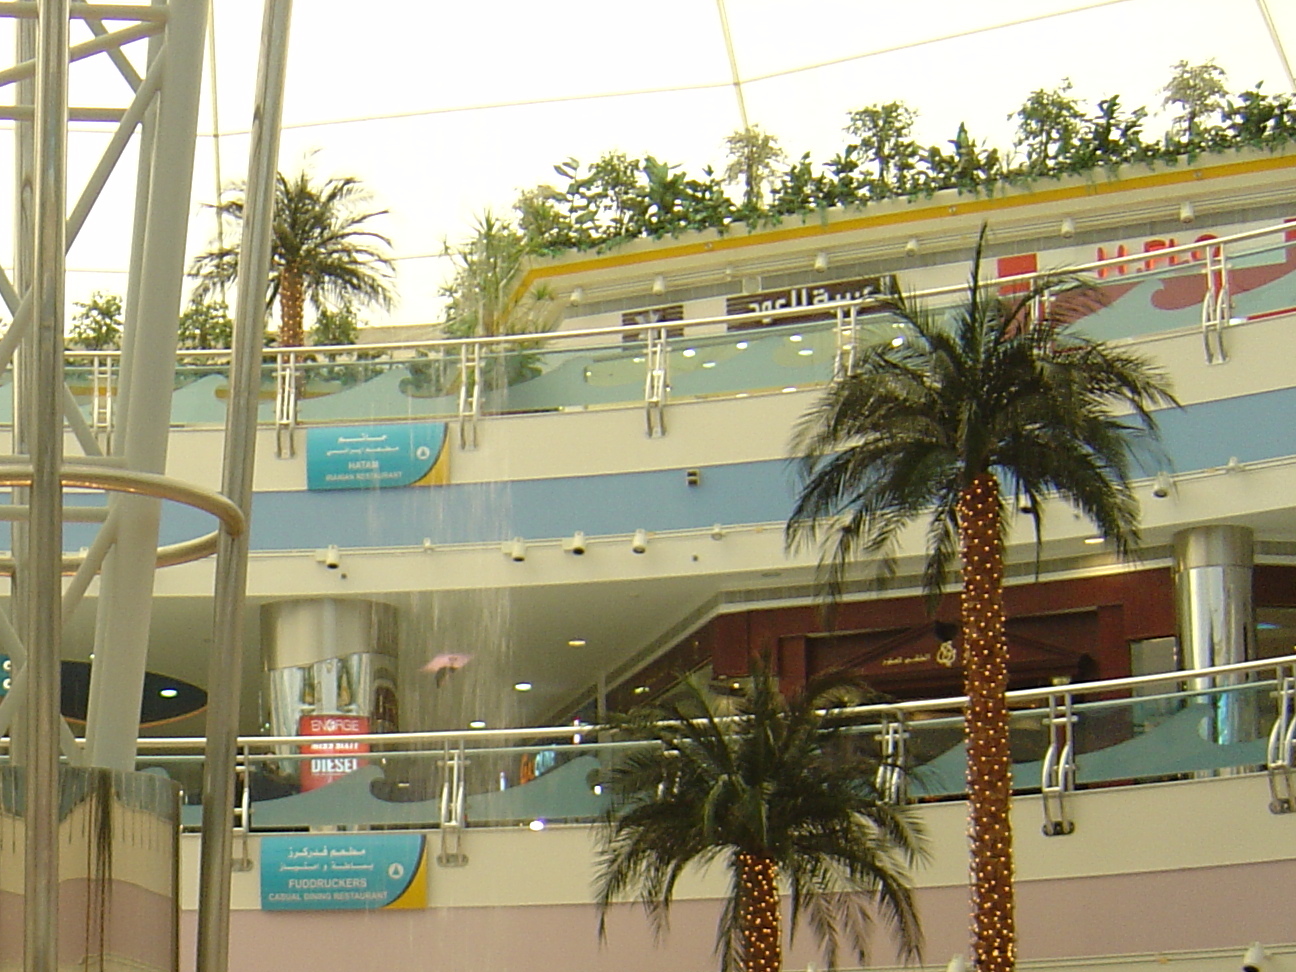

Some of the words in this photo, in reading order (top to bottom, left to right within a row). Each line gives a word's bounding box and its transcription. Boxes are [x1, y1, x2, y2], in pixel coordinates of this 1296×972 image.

[288, 878, 368, 889] FUDDRUCKERS
[268, 893, 302, 901] CASUAL
[333, 891, 388, 900] RESTAURANT
